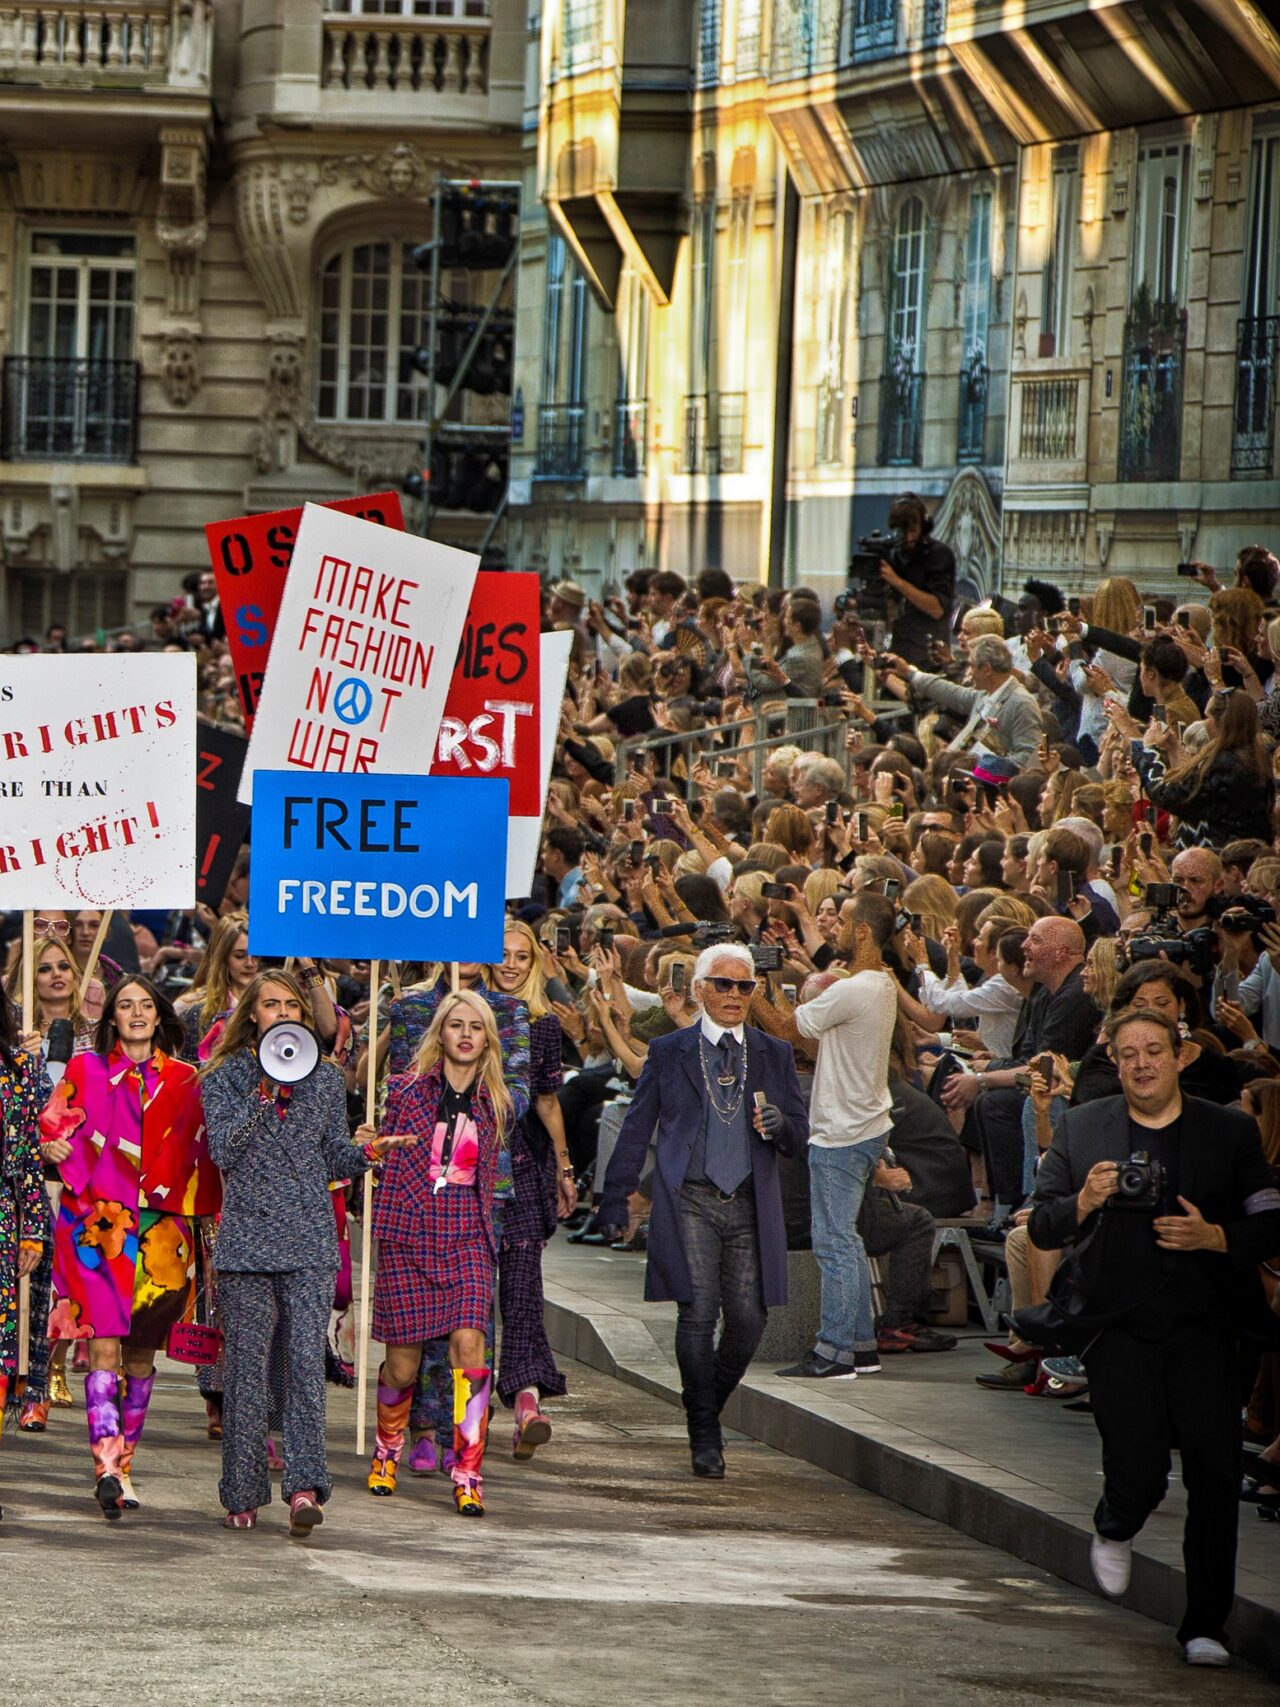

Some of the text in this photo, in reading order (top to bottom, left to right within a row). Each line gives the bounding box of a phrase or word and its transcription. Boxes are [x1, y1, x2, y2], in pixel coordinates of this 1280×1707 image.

[314, 555, 419, 630] MAKE
[298, 608, 435, 690] FASHION
[453, 621, 529, 685] IES
[1, 700, 177, 760] RIGHTS
[287, 718, 379, 774] WAR
[431, 699, 533, 772] RST
[41, 780, 108, 797] THAN
[284, 797, 419, 853] FREE
[278, 880, 478, 919] FREEDOM
